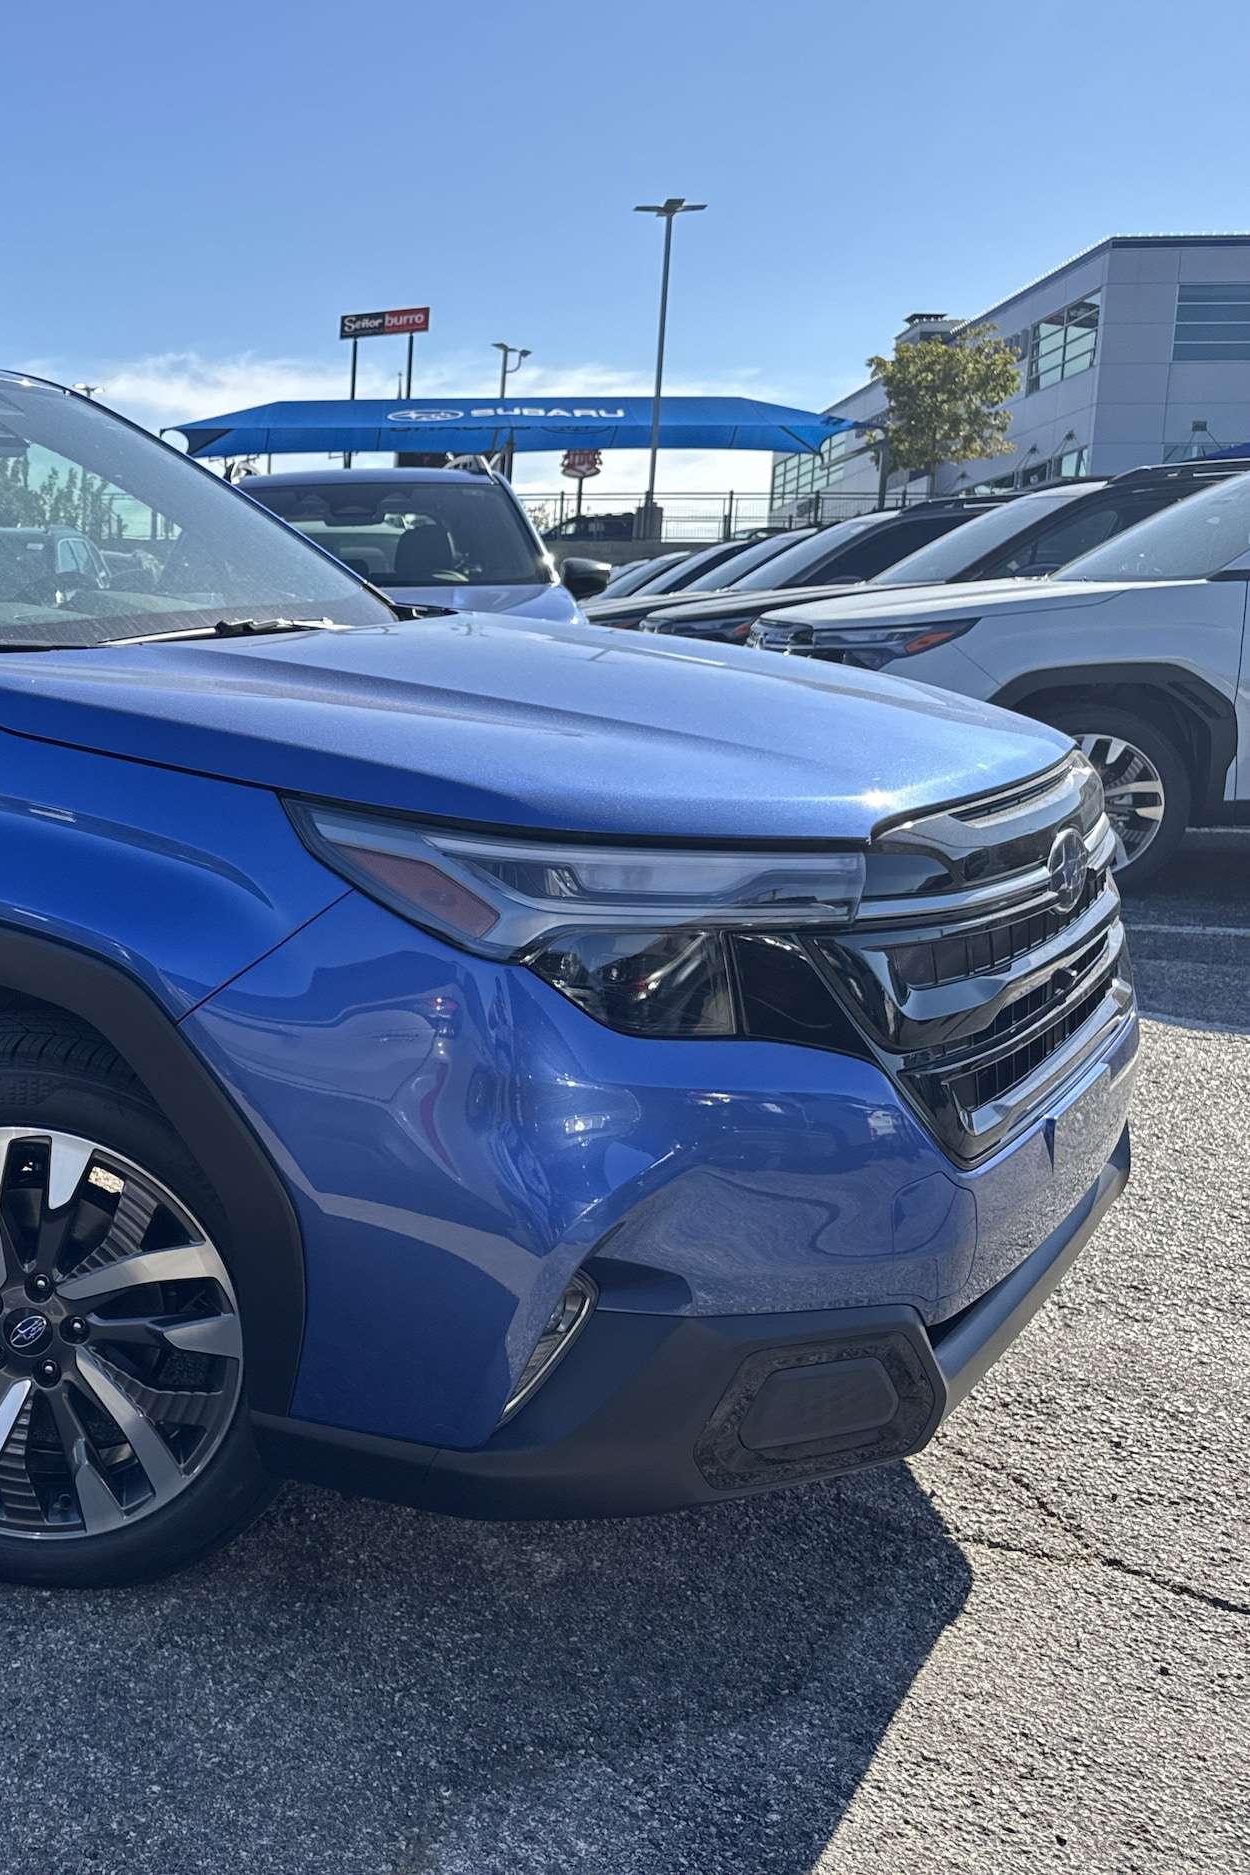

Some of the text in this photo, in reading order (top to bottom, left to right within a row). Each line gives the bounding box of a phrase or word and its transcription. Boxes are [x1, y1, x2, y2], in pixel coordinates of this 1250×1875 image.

[344, 316, 383, 332] Señor
[384, 313, 425, 327] burro
[470, 407, 625, 418] SUBARU
